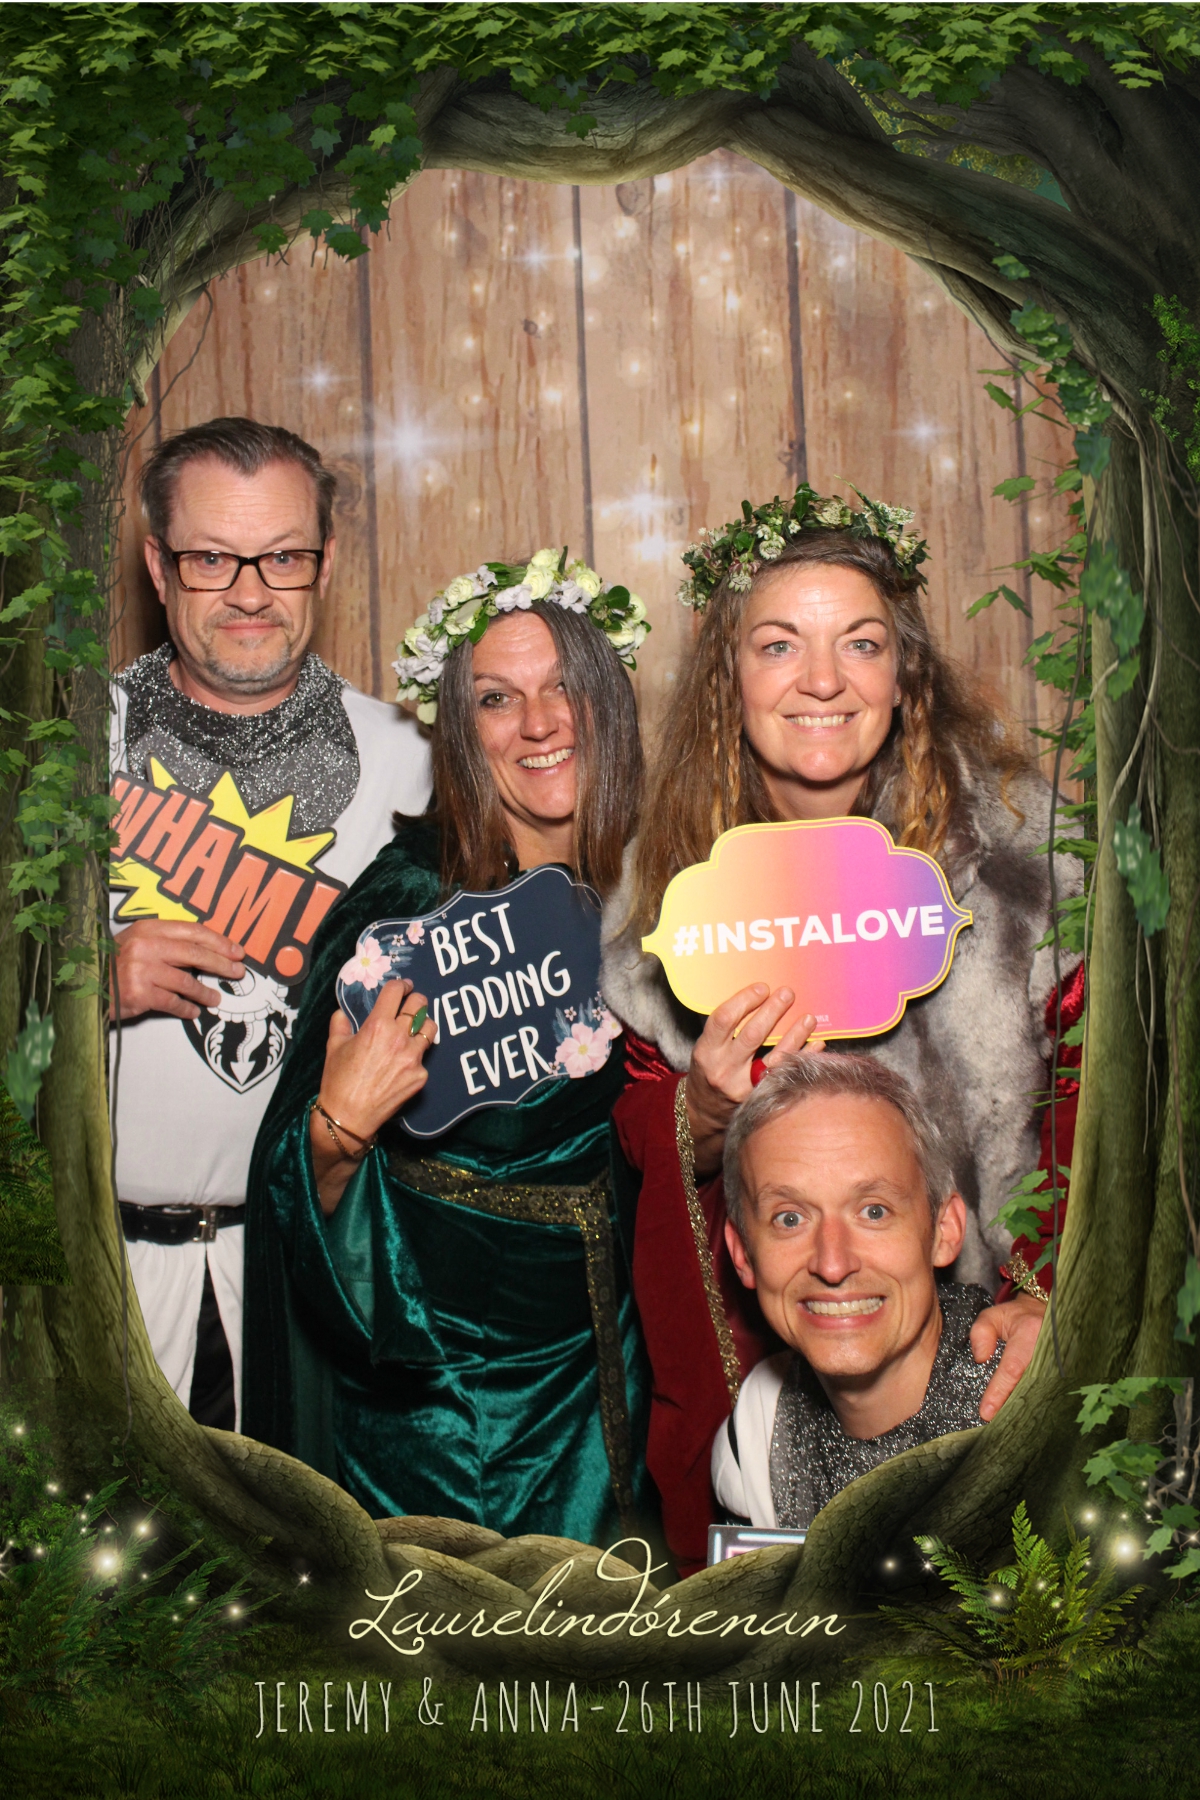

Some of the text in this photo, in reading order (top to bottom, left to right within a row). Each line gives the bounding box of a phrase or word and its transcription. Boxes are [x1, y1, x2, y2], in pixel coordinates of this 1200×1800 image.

[109, 776, 342, 977] WHAM!
[430, 902, 516, 977] BEST
[672, 904, 946, 957] #INSTALOVE
[459, 1025, 552, 1096] EVER
